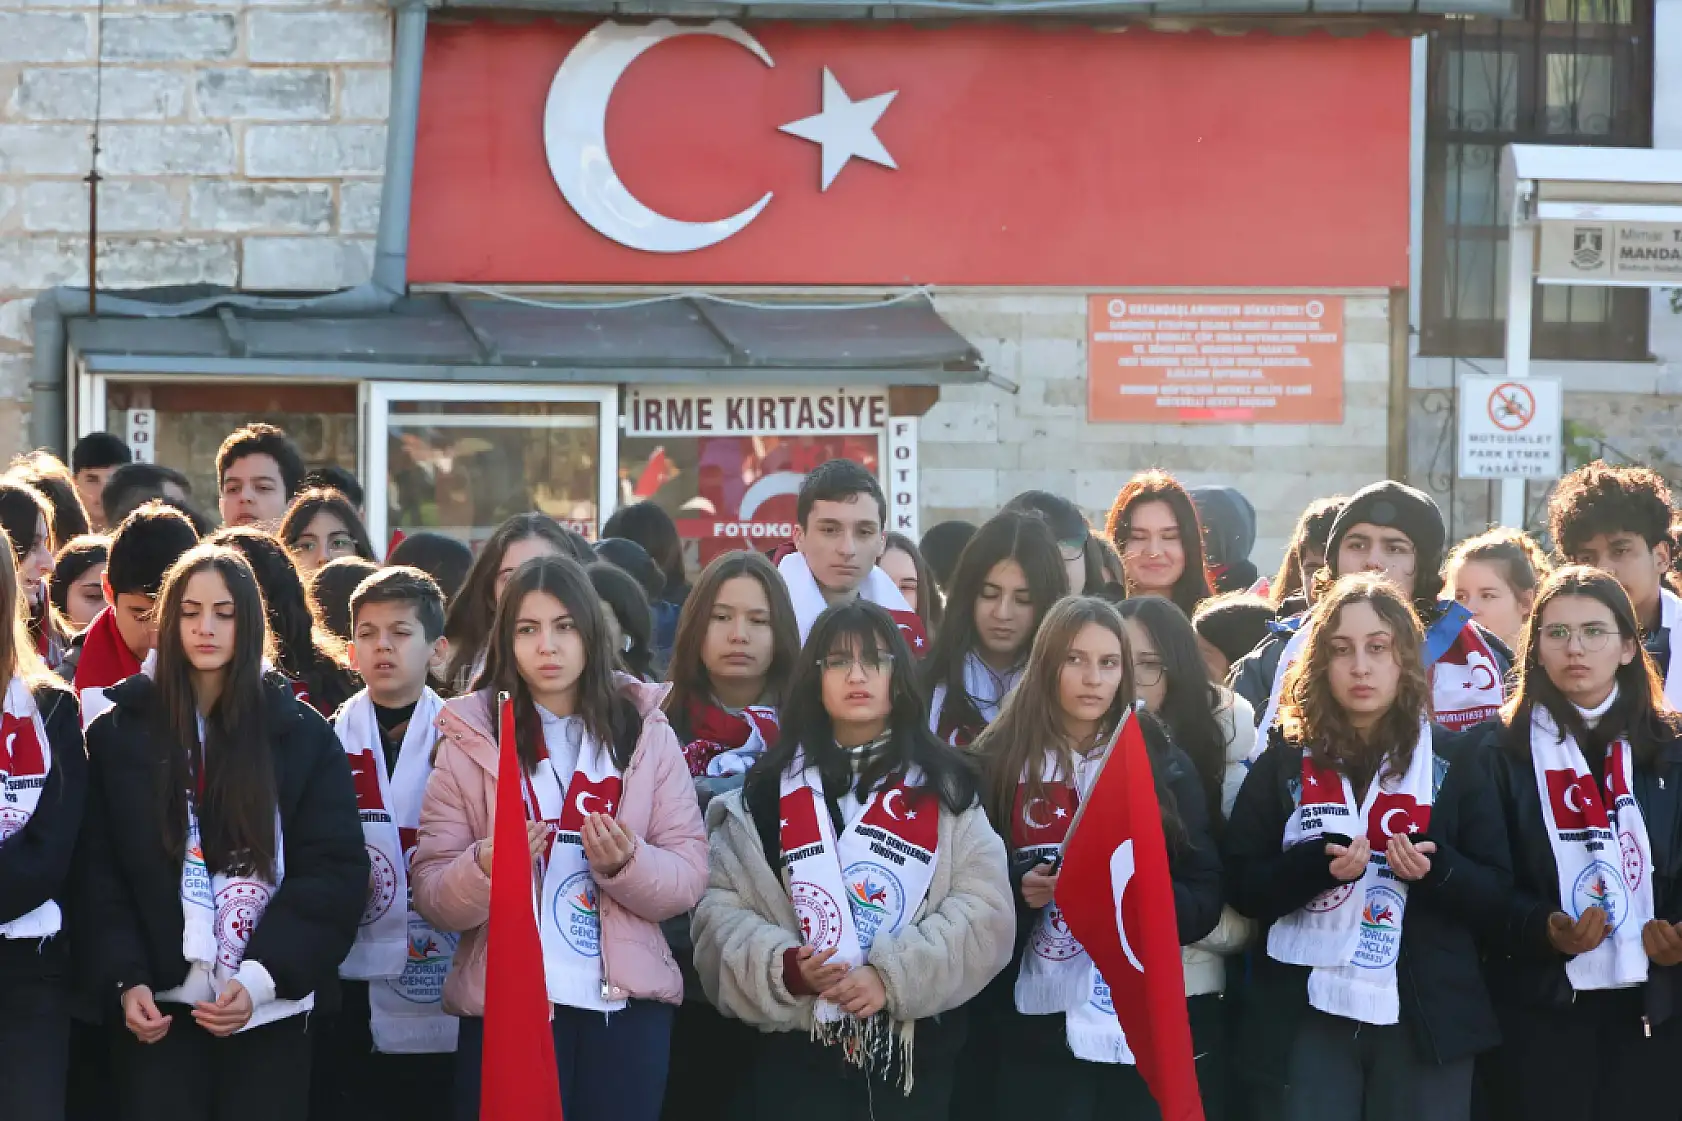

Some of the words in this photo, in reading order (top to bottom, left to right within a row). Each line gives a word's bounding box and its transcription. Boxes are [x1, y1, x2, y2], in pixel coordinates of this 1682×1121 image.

[633, 390, 713, 431] İRME
[726, 387, 886, 430] KIRTASİYE
[1469, 450, 1502, 458] PARK
[895, 424, 912, 528] FOTOK
[713, 522, 792, 537] FOTOKO
[405, 963, 447, 975] ODRUM
